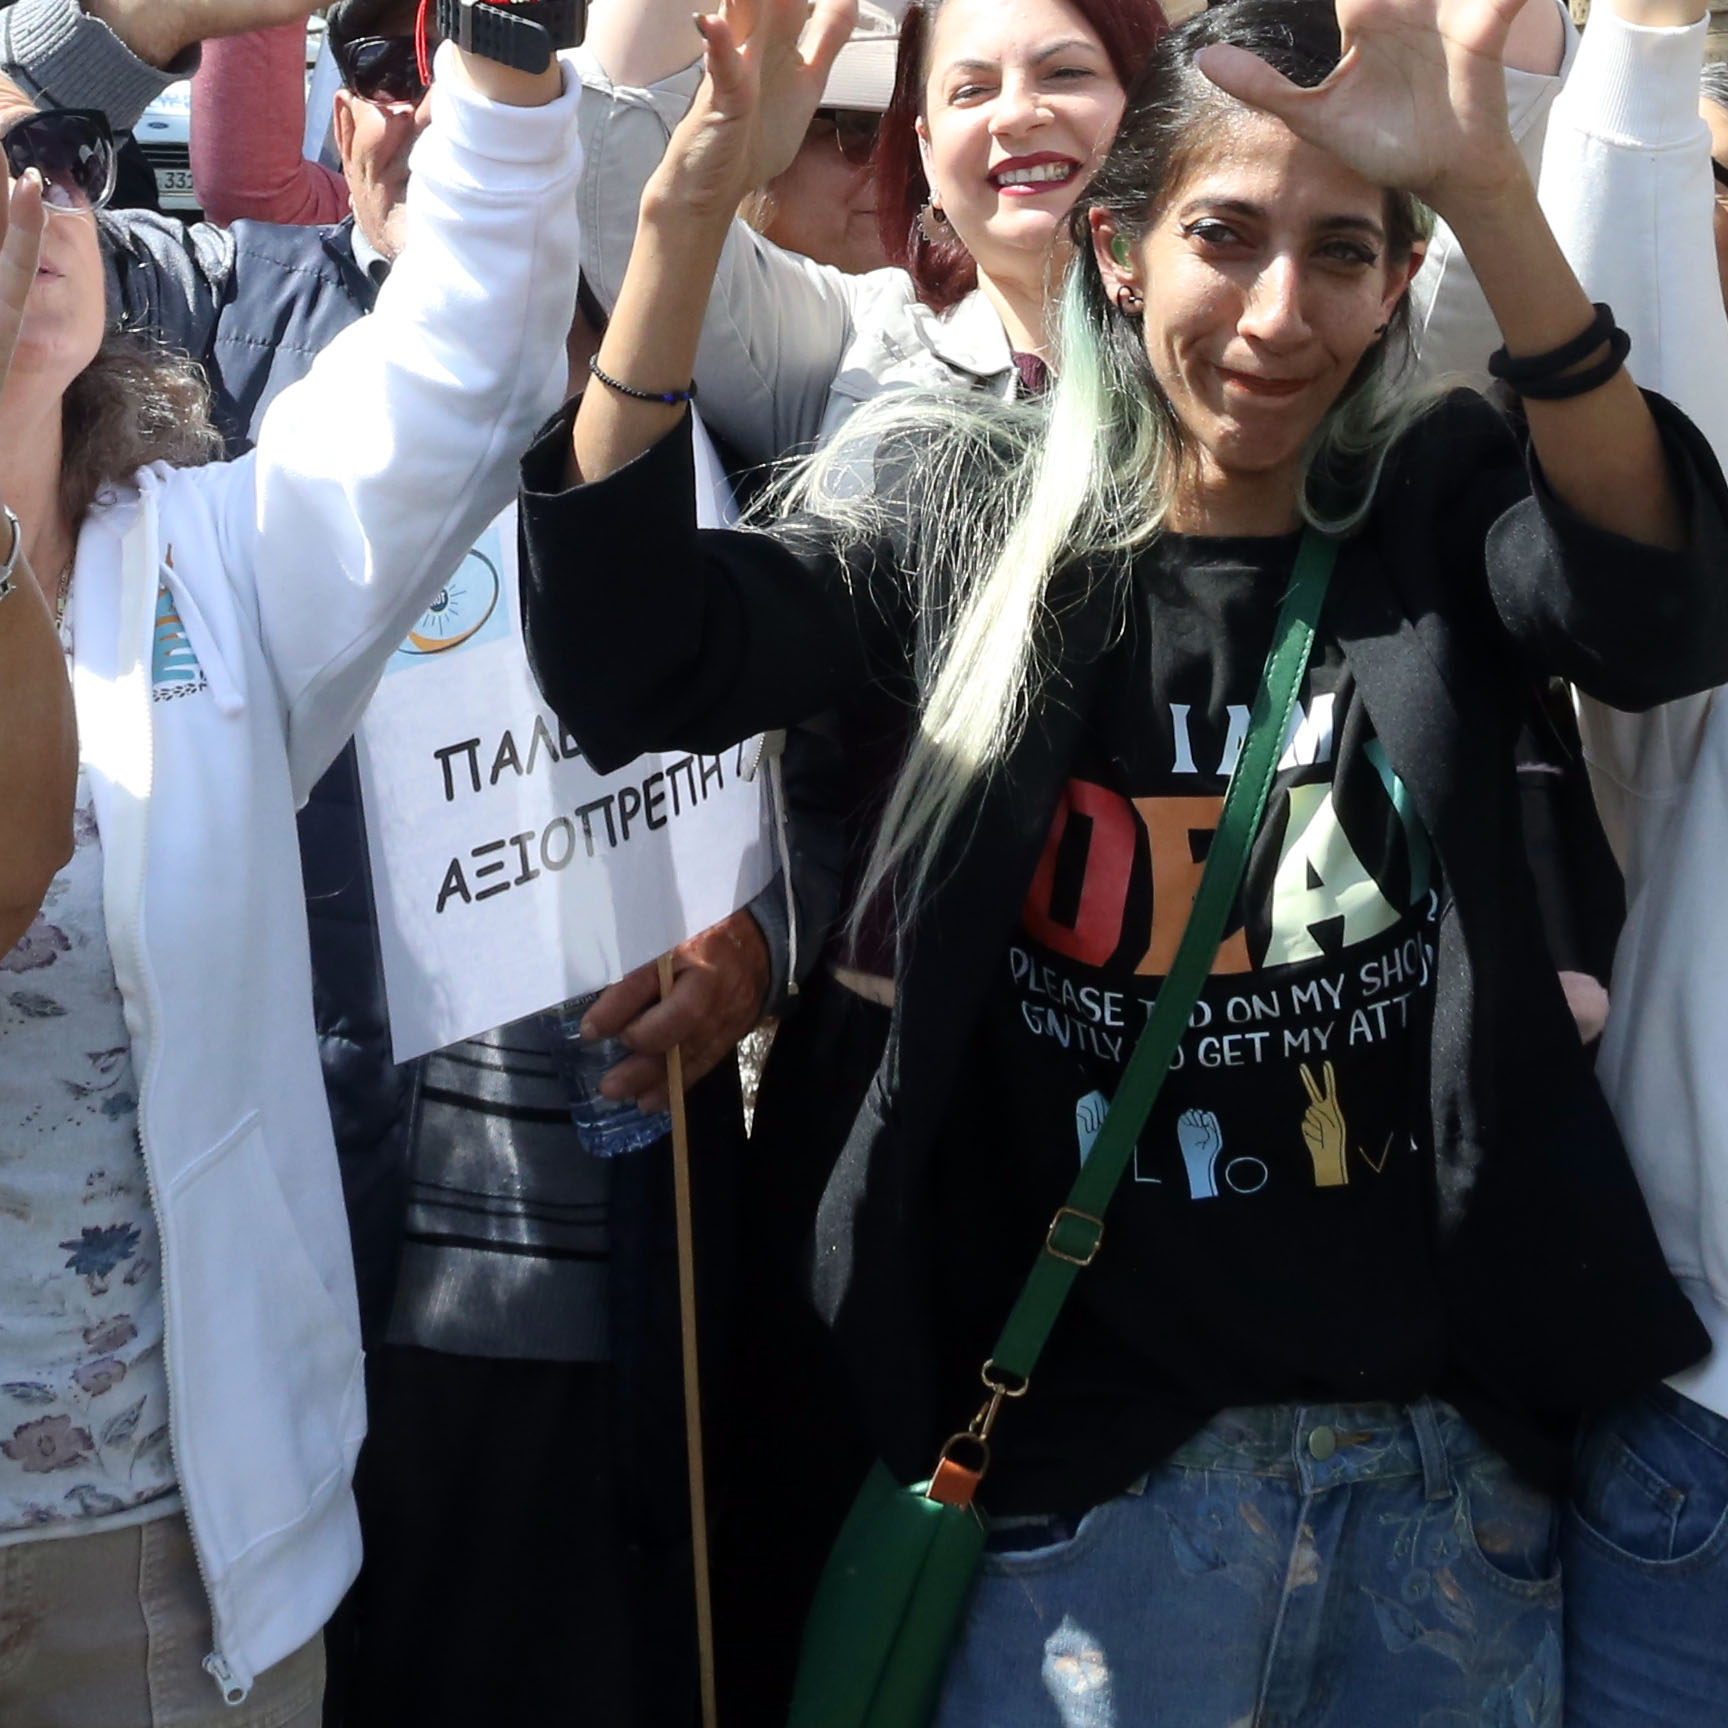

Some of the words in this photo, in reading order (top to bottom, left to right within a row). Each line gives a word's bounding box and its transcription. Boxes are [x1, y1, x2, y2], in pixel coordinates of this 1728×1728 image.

[1169, 704, 1198, 773] I
[1010, 946, 1125, 1027] PLEASE
[1226, 989, 1281, 1022] ON
[1291, 973, 1345, 1015] MY
[1198, 1031, 1270, 1069] GET
[1284, 1021, 1336, 1059] MY
